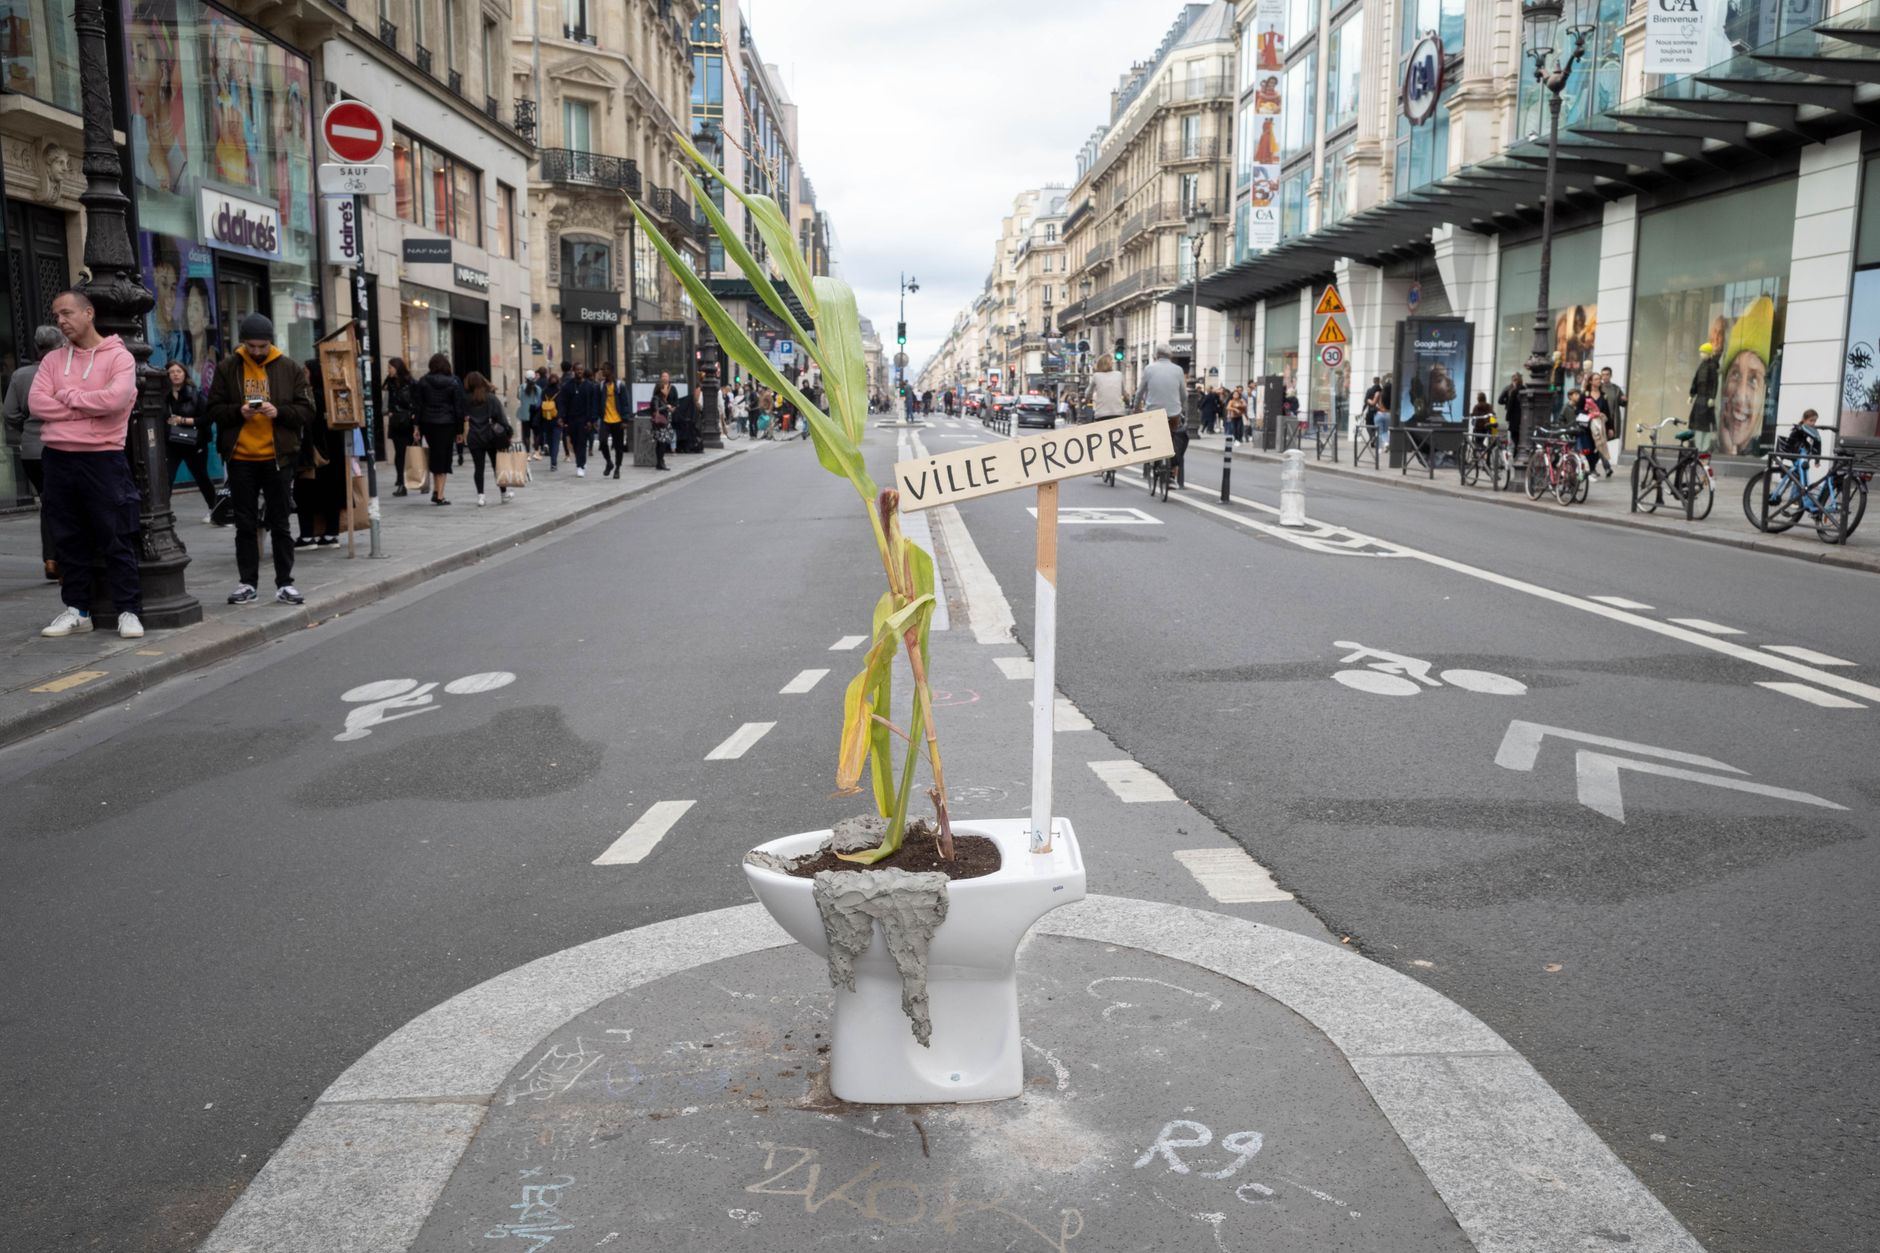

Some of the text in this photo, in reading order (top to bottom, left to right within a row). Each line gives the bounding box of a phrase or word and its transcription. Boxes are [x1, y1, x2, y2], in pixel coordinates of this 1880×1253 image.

[1653, 14, 1698, 23] Bienvenue
[339, 167, 369, 176] SAUF
[213, 200, 276, 252] claire's
[338, 201, 355, 258] claire's
[580, 307, 618, 321] Bershka
[782, 343, 790, 352] P
[1414, 340, 1458, 349] Google Pixel 7
[1326, 351, 1339, 361] 30
[1020, 423, 1152, 478] PROPRE
